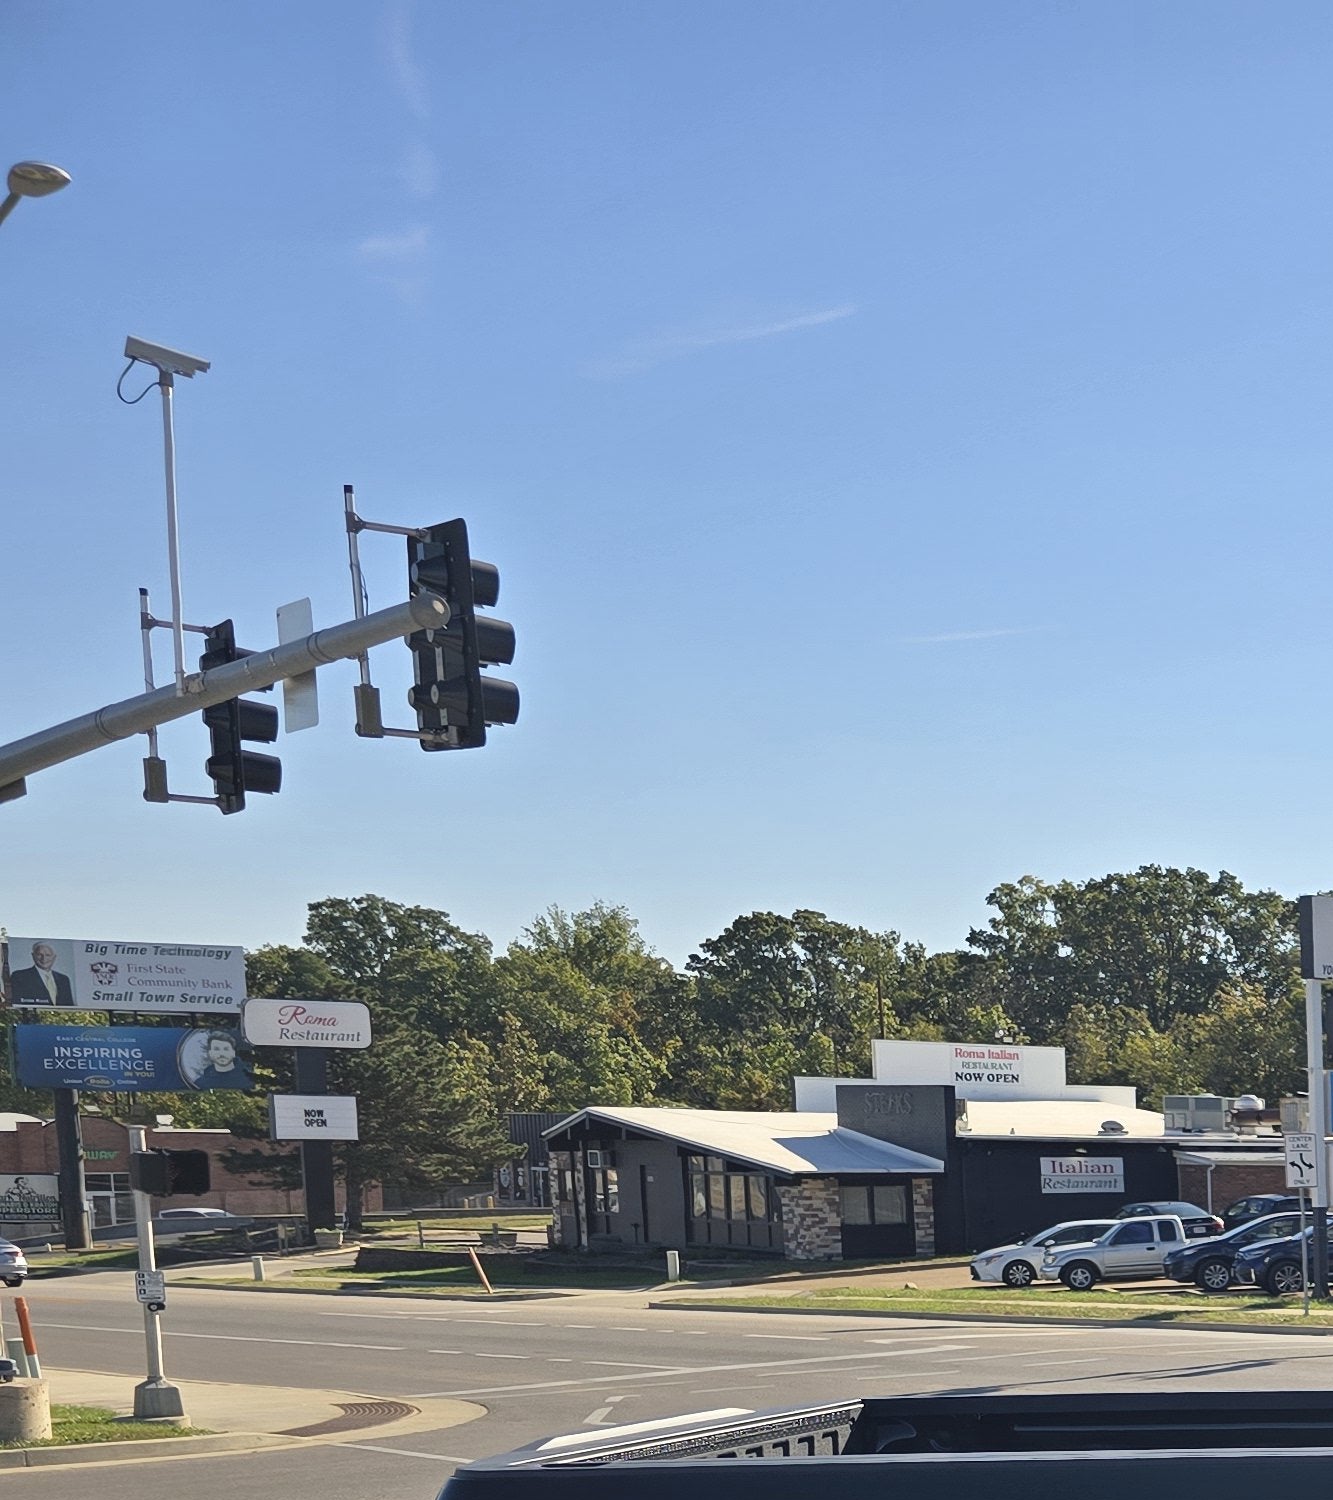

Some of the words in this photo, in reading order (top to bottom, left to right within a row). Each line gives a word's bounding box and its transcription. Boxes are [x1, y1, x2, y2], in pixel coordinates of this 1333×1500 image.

[85, 943, 108, 955] Big
[114, 944, 147, 955] Time
[152, 945, 231, 960] Technology
[127, 963, 153, 973] First
[155, 964, 186, 974] State
[128, 977, 199, 990] Community
[202, 979, 232, 989] Bank
[92, 990, 133, 1002] Small
[139, 992, 174, 1003] Town
[180, 993, 233, 1005] Service
[278, 1005, 338, 1026] Roma
[279, 1027, 361, 1042] Restaurant
[54, 1046, 142, 1058] INSPIRING
[954, 1047, 985, 1059] Roma
[987, 1048, 1020, 1060] Italian
[43, 1058, 155, 1070] EXCELLENCE
[961, 1061, 1013, 1070] RESTAURANT
[955, 1071, 985, 1082] NOW
[986, 1073, 1020, 1083] OPEN
[304, 1109, 324, 1118] NOW
[304, 1118, 327, 1127] OPEN
[1051, 1160, 1115, 1173] Italian
[1042, 1177, 1118, 1189] Restaurant
